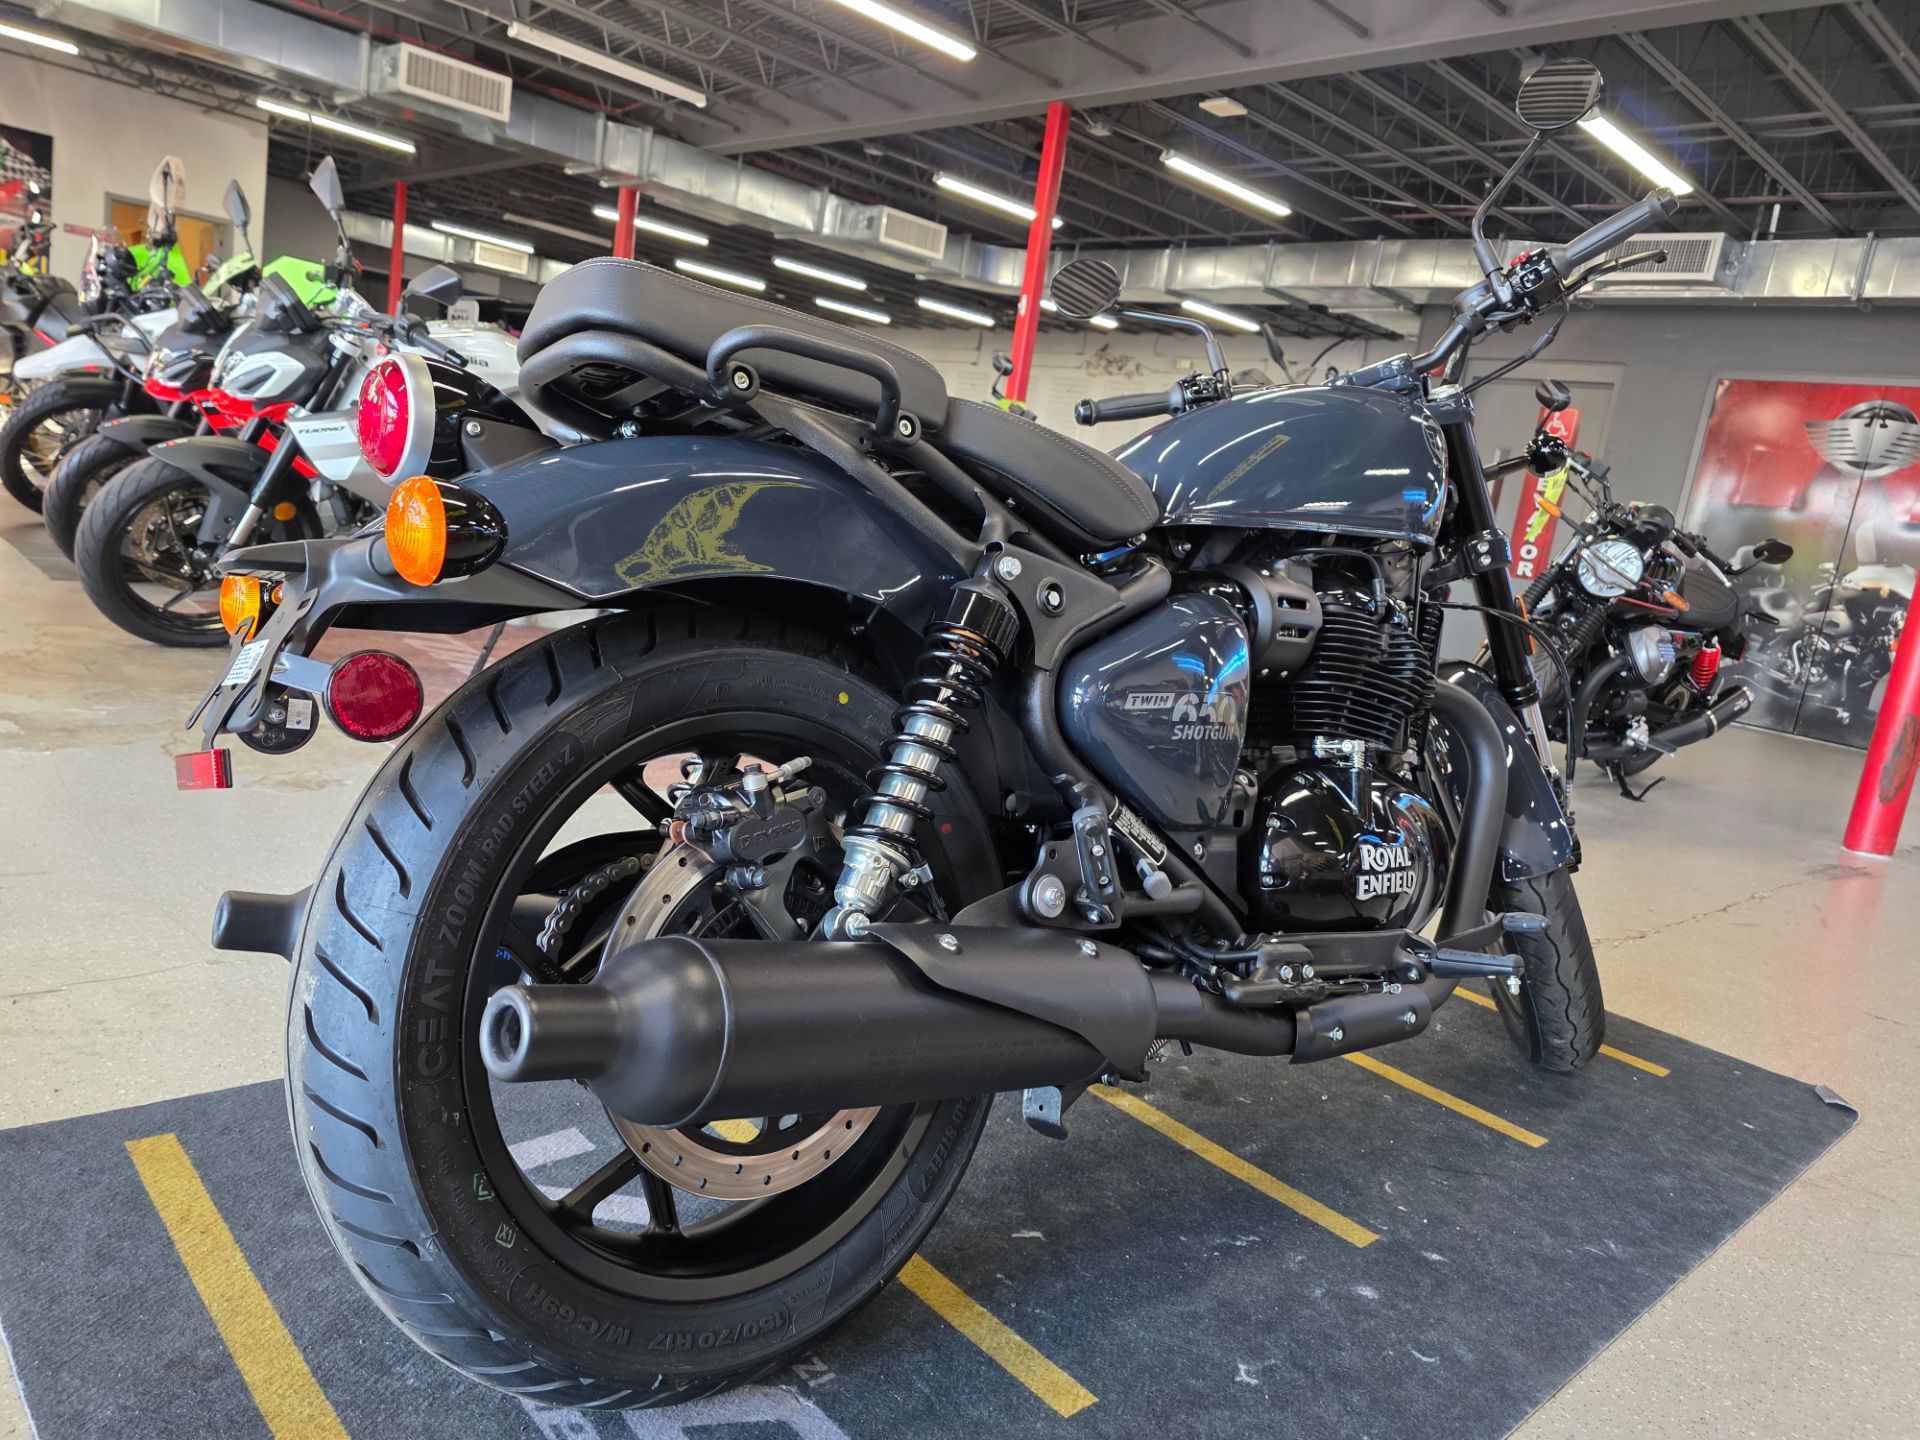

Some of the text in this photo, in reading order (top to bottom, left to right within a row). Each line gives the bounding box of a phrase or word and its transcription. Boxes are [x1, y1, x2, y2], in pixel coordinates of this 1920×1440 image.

[1131, 695, 1170, 707] TWIN
[1172, 692, 1237, 723] 650
[1171, 724, 1235, 741] SHOTGUN
[439, 859, 488, 948] ZOOM
[482, 811, 515, 857] RAD
[512, 758, 561, 814] STEEL
[1360, 843, 1412, 872] ROYAL
[1356, 871, 1417, 901] ENFIELD
[698, 1311, 786, 1347] 150/70
